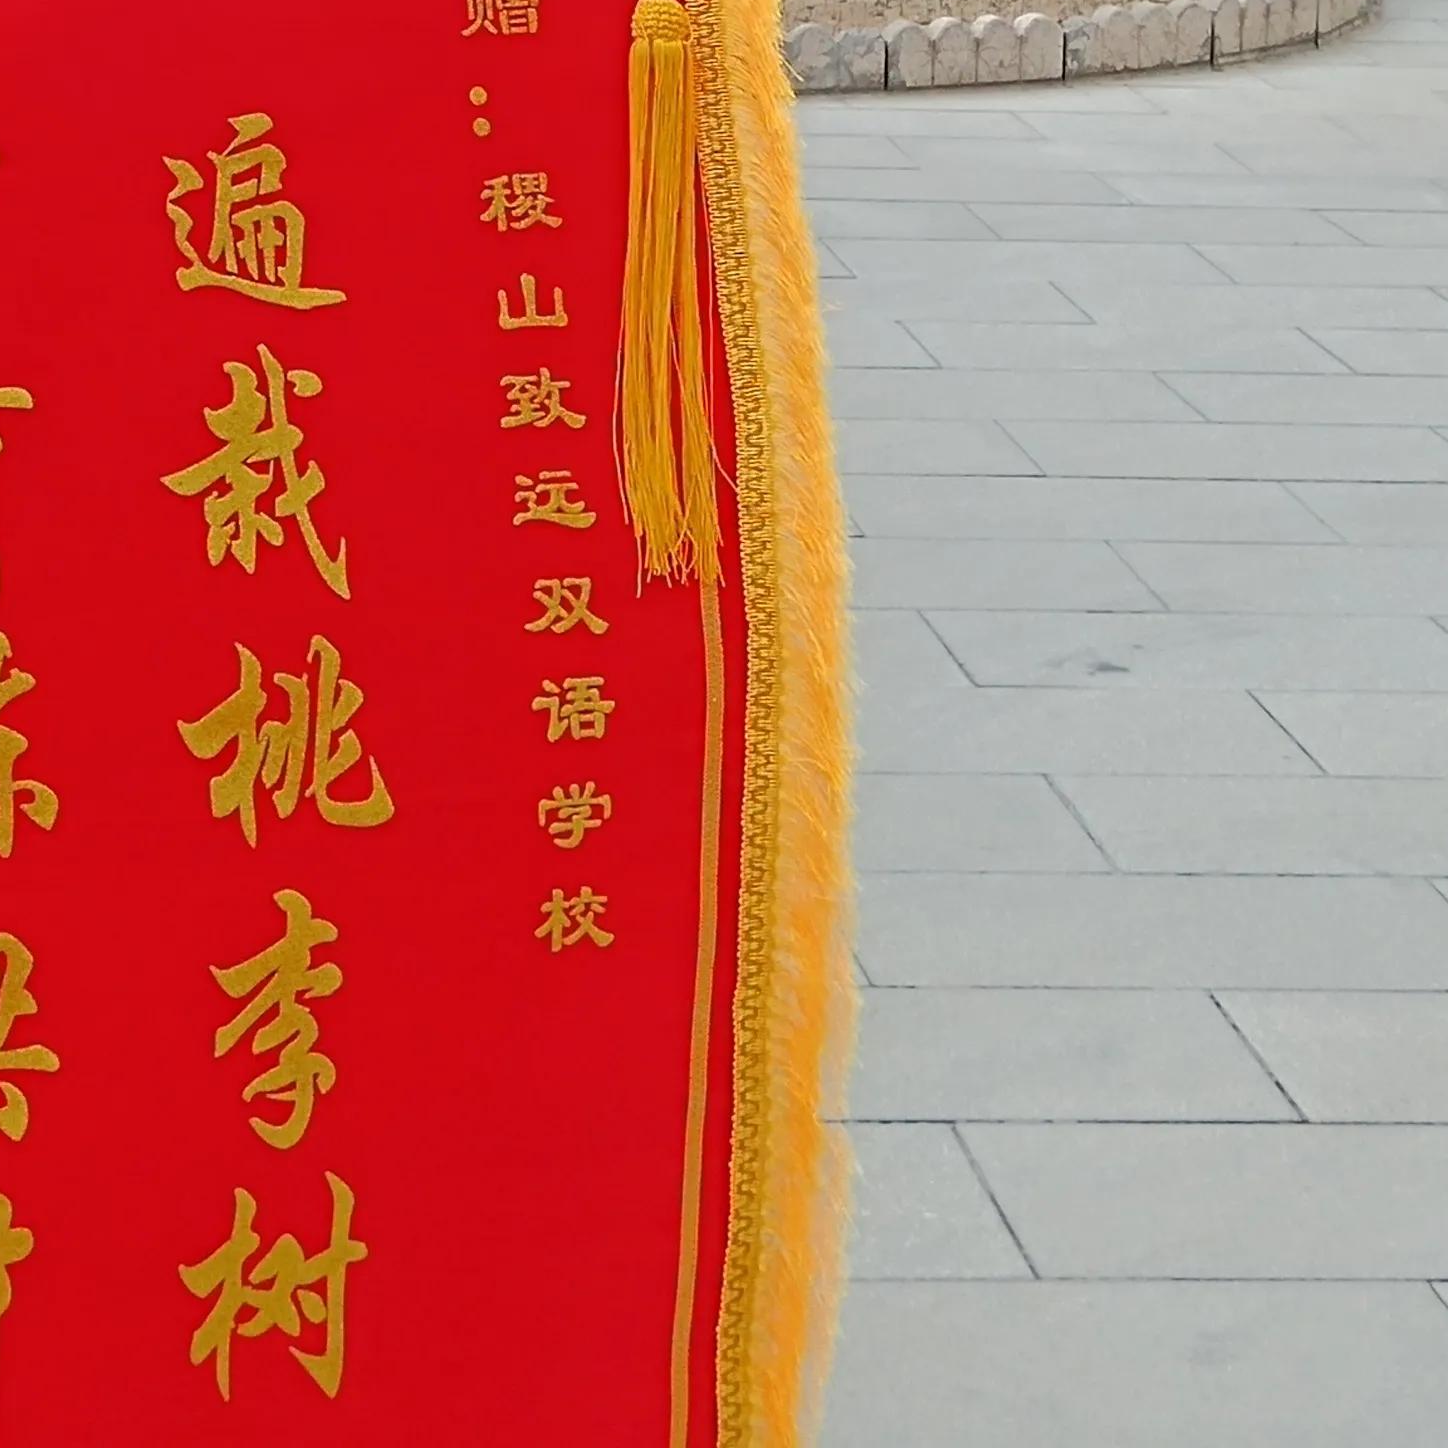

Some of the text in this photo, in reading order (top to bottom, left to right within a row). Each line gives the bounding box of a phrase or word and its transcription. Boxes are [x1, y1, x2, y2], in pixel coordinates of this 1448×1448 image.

[160, 110, 397, 1402] 遍栽桃李树
